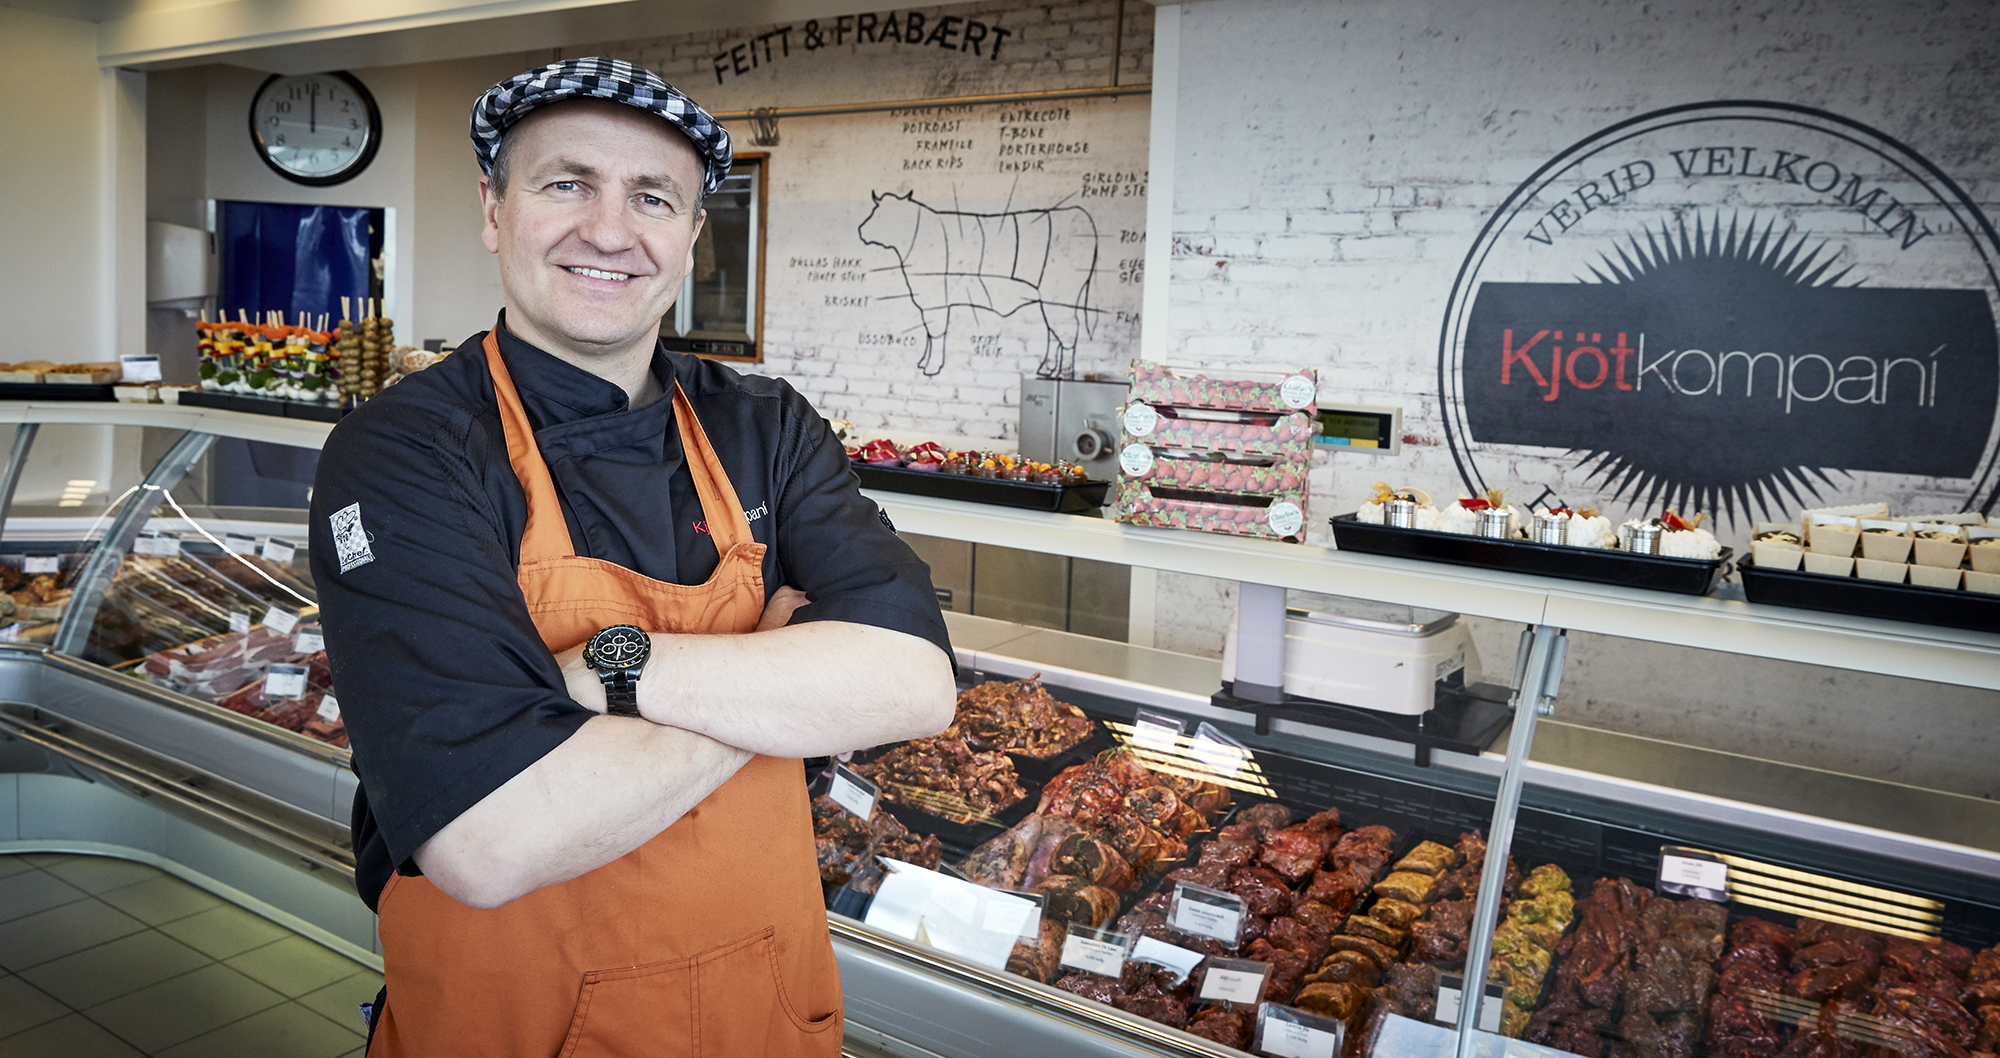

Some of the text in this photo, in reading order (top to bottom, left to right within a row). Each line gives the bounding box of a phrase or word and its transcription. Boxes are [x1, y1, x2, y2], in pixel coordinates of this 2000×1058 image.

[713, 11, 1012, 85] FEITT & FRABÆRT
[275, 100, 292, 114] 10
[340, 99, 351, 113] 2
[269, 115, 280, 128] 9
[350, 117, 359, 131] 3
[1523, 145, 1936, 252] VERIÐ VELKOMIN
[1500, 328, 1948, 414] Kjötkompaní
